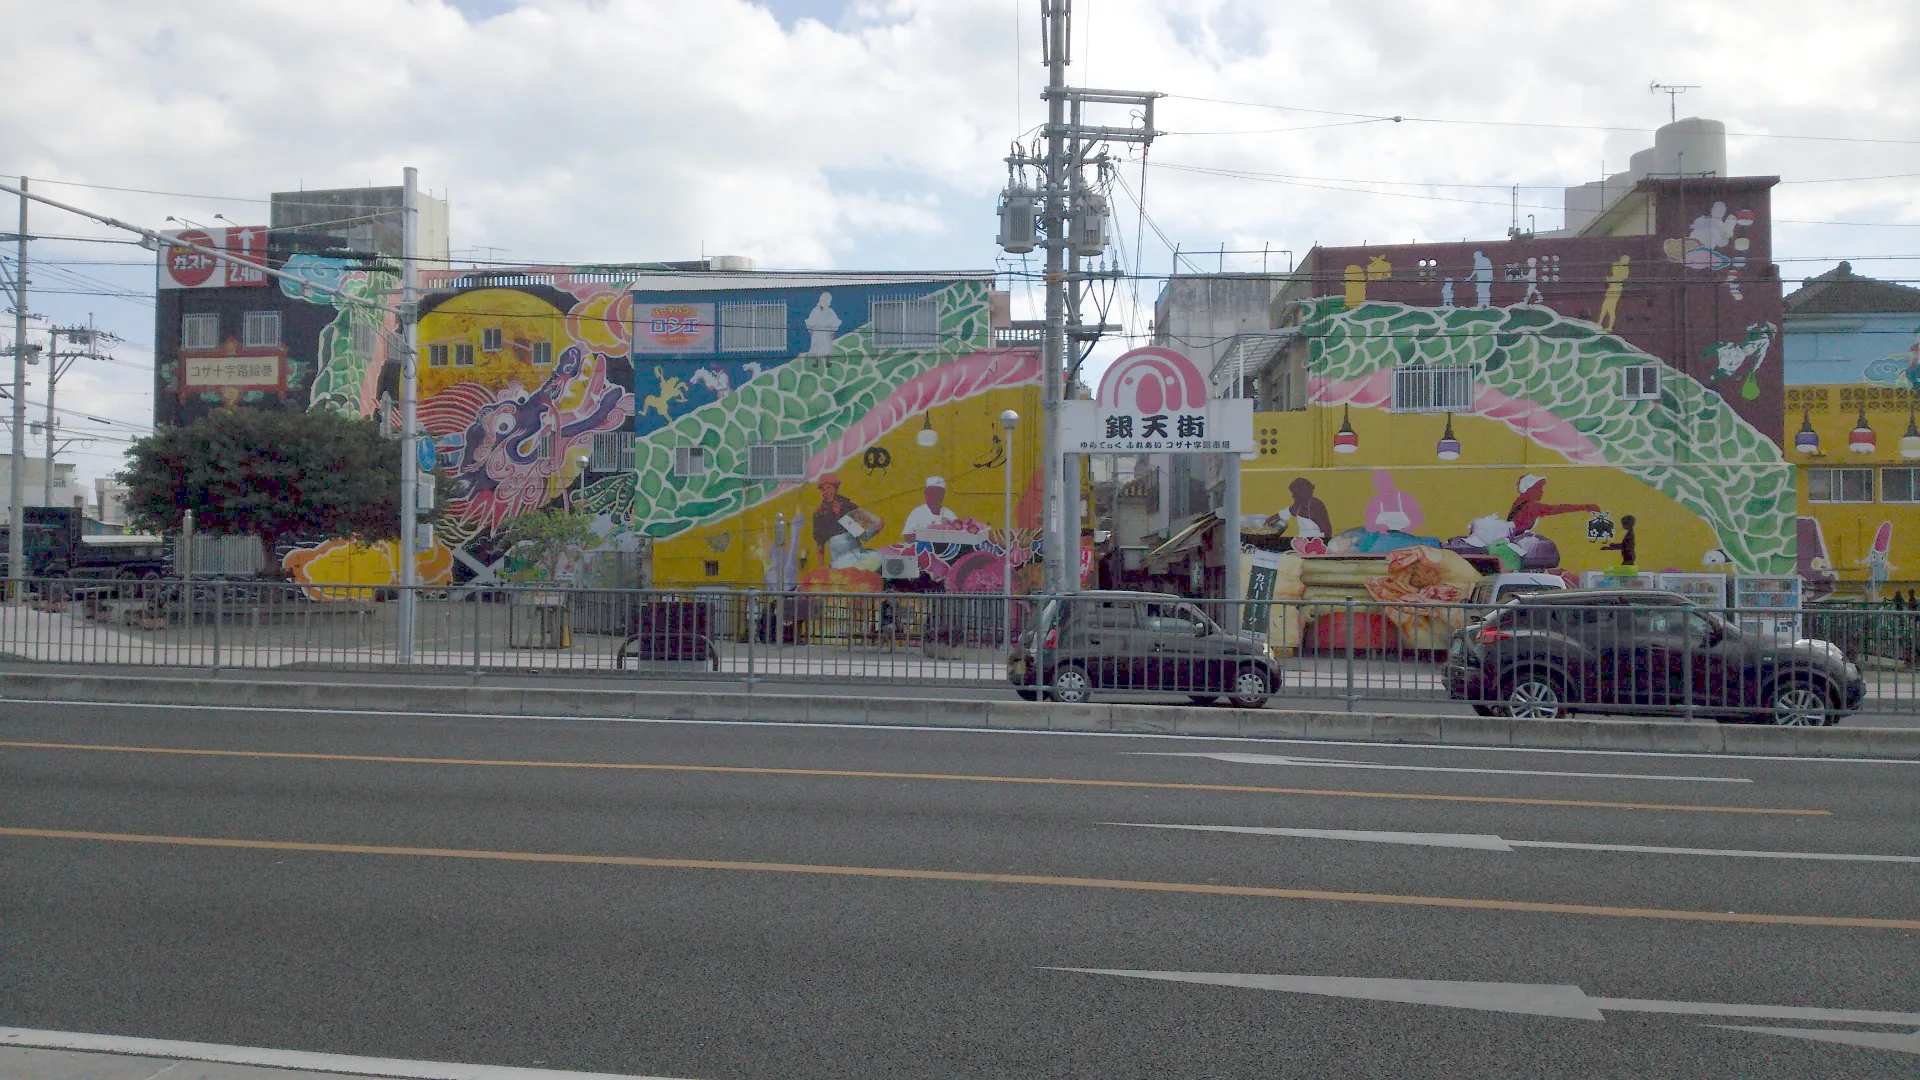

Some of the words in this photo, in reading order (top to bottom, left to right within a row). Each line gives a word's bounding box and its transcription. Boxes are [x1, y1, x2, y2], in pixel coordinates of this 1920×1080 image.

[174, 254, 211, 269] ガスト
[652, 305, 696, 315] パーマハウス
[191, 364, 272, 377] コザ十字路絵巻
[1106, 415, 1204, 438] 銀天街
[1126, 441, 1162, 449] ふれあい
